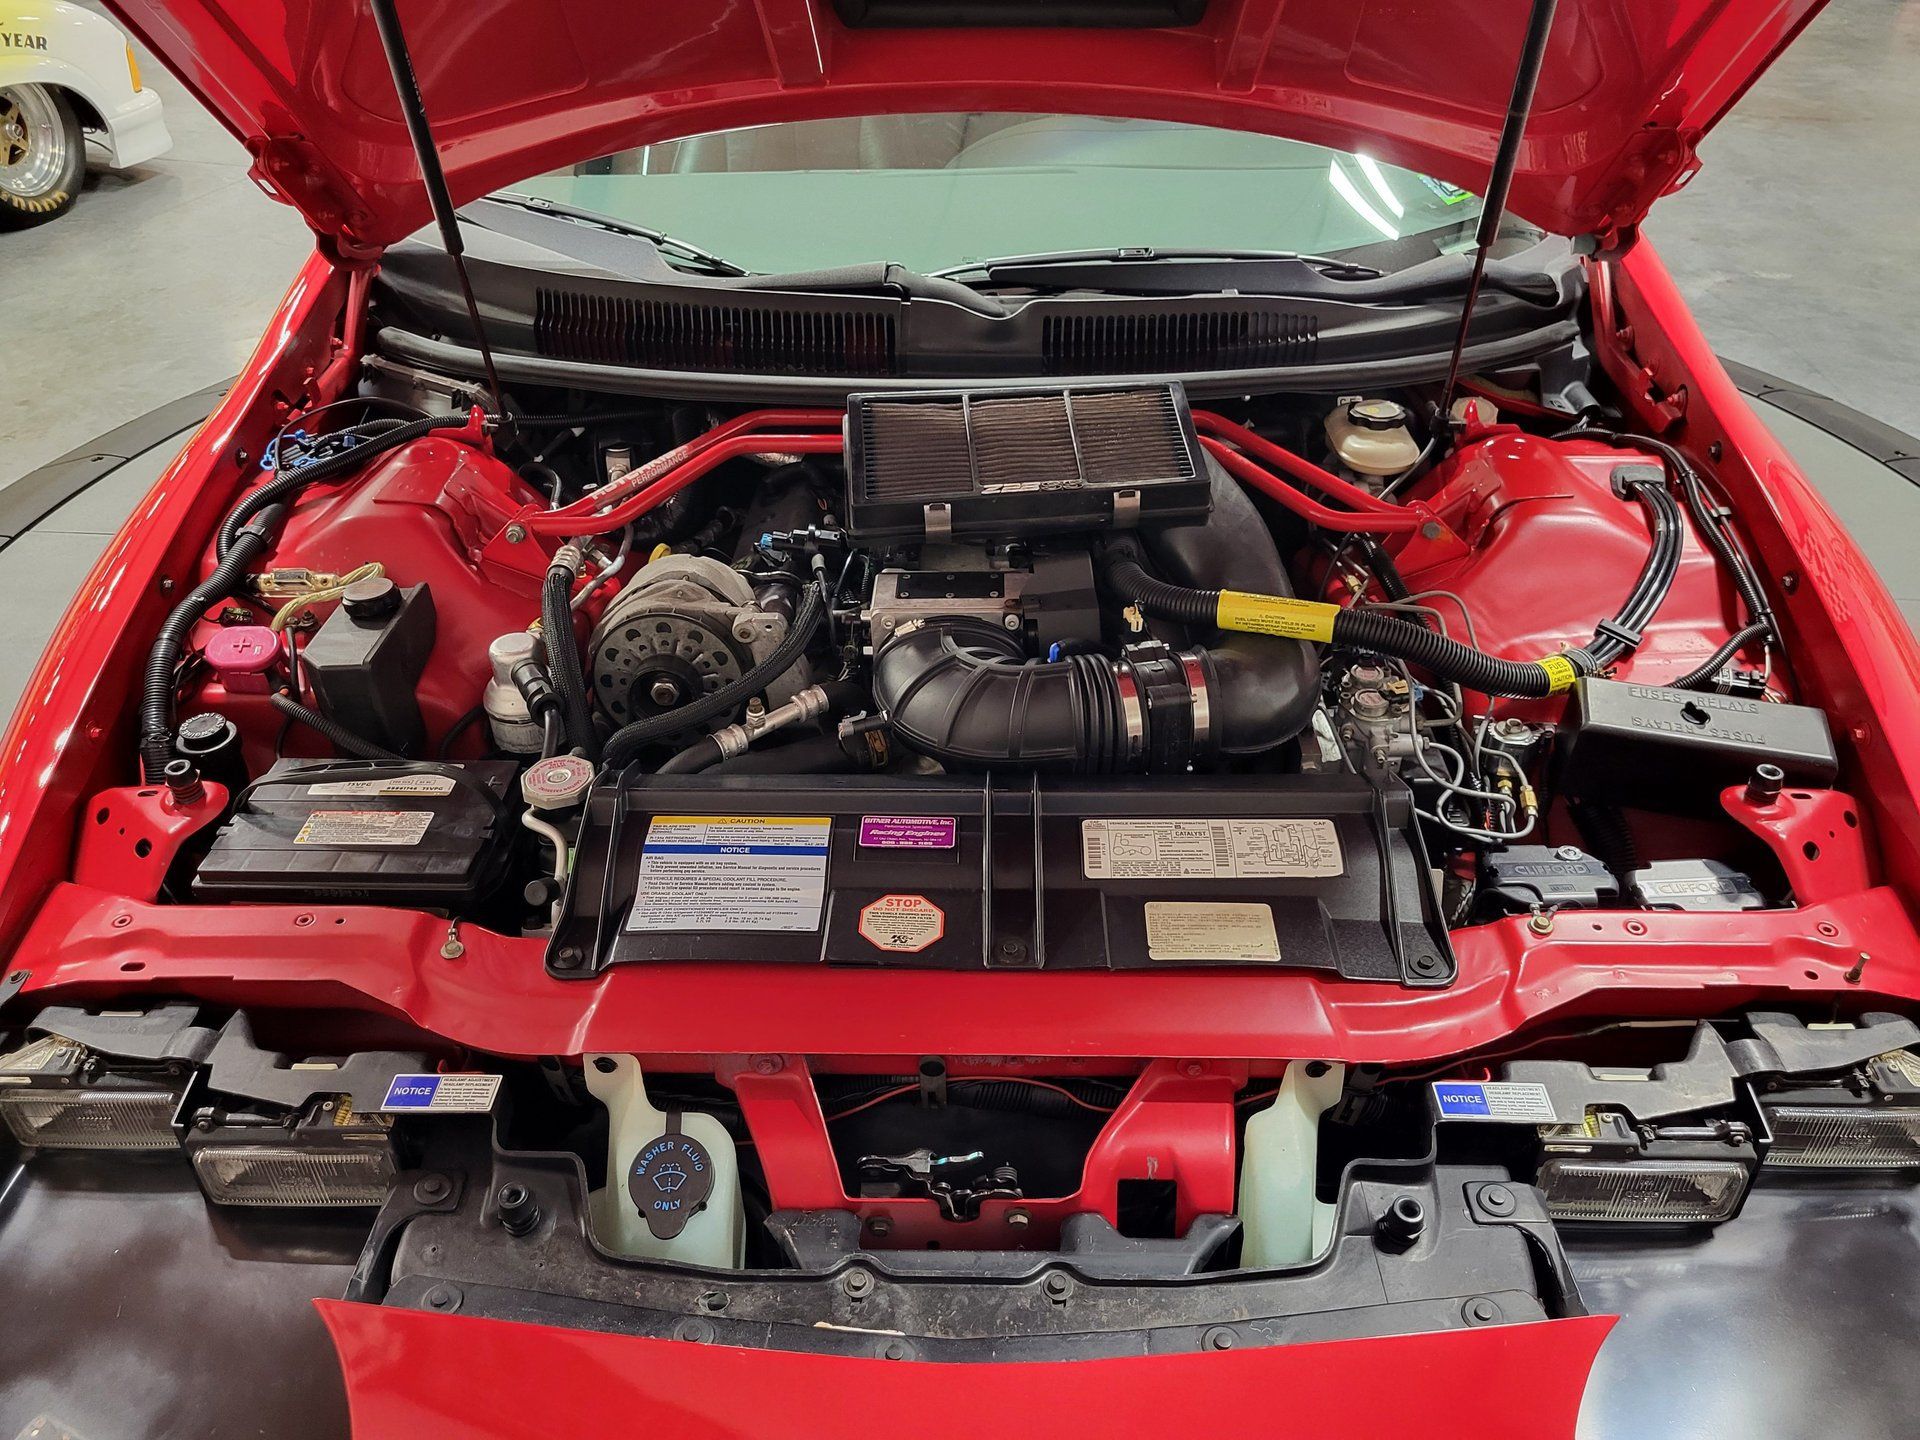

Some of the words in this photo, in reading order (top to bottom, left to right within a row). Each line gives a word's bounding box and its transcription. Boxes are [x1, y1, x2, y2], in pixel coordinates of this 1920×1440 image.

[1, 32, 47, 50] YEAR
[631, 450, 689, 487] PERFORMANCE
[1548, 661, 1567, 671] FUEL
[1630, 687, 1681, 703] FUSES
[1697, 697, 1759, 714] RELAYS
[1514, 864, 1587, 876] CLIFFORD
[1660, 879, 1736, 894] CLIFFORD
[885, 898, 922, 907] STOP
[394, 1087, 432, 1095] NOTICE
[1443, 1095, 1483, 1104] NOTICE
[636, 1141, 674, 1175] WASHER
[681, 1143, 704, 1172] FLUID
[654, 1199, 681, 1211] ONLY
